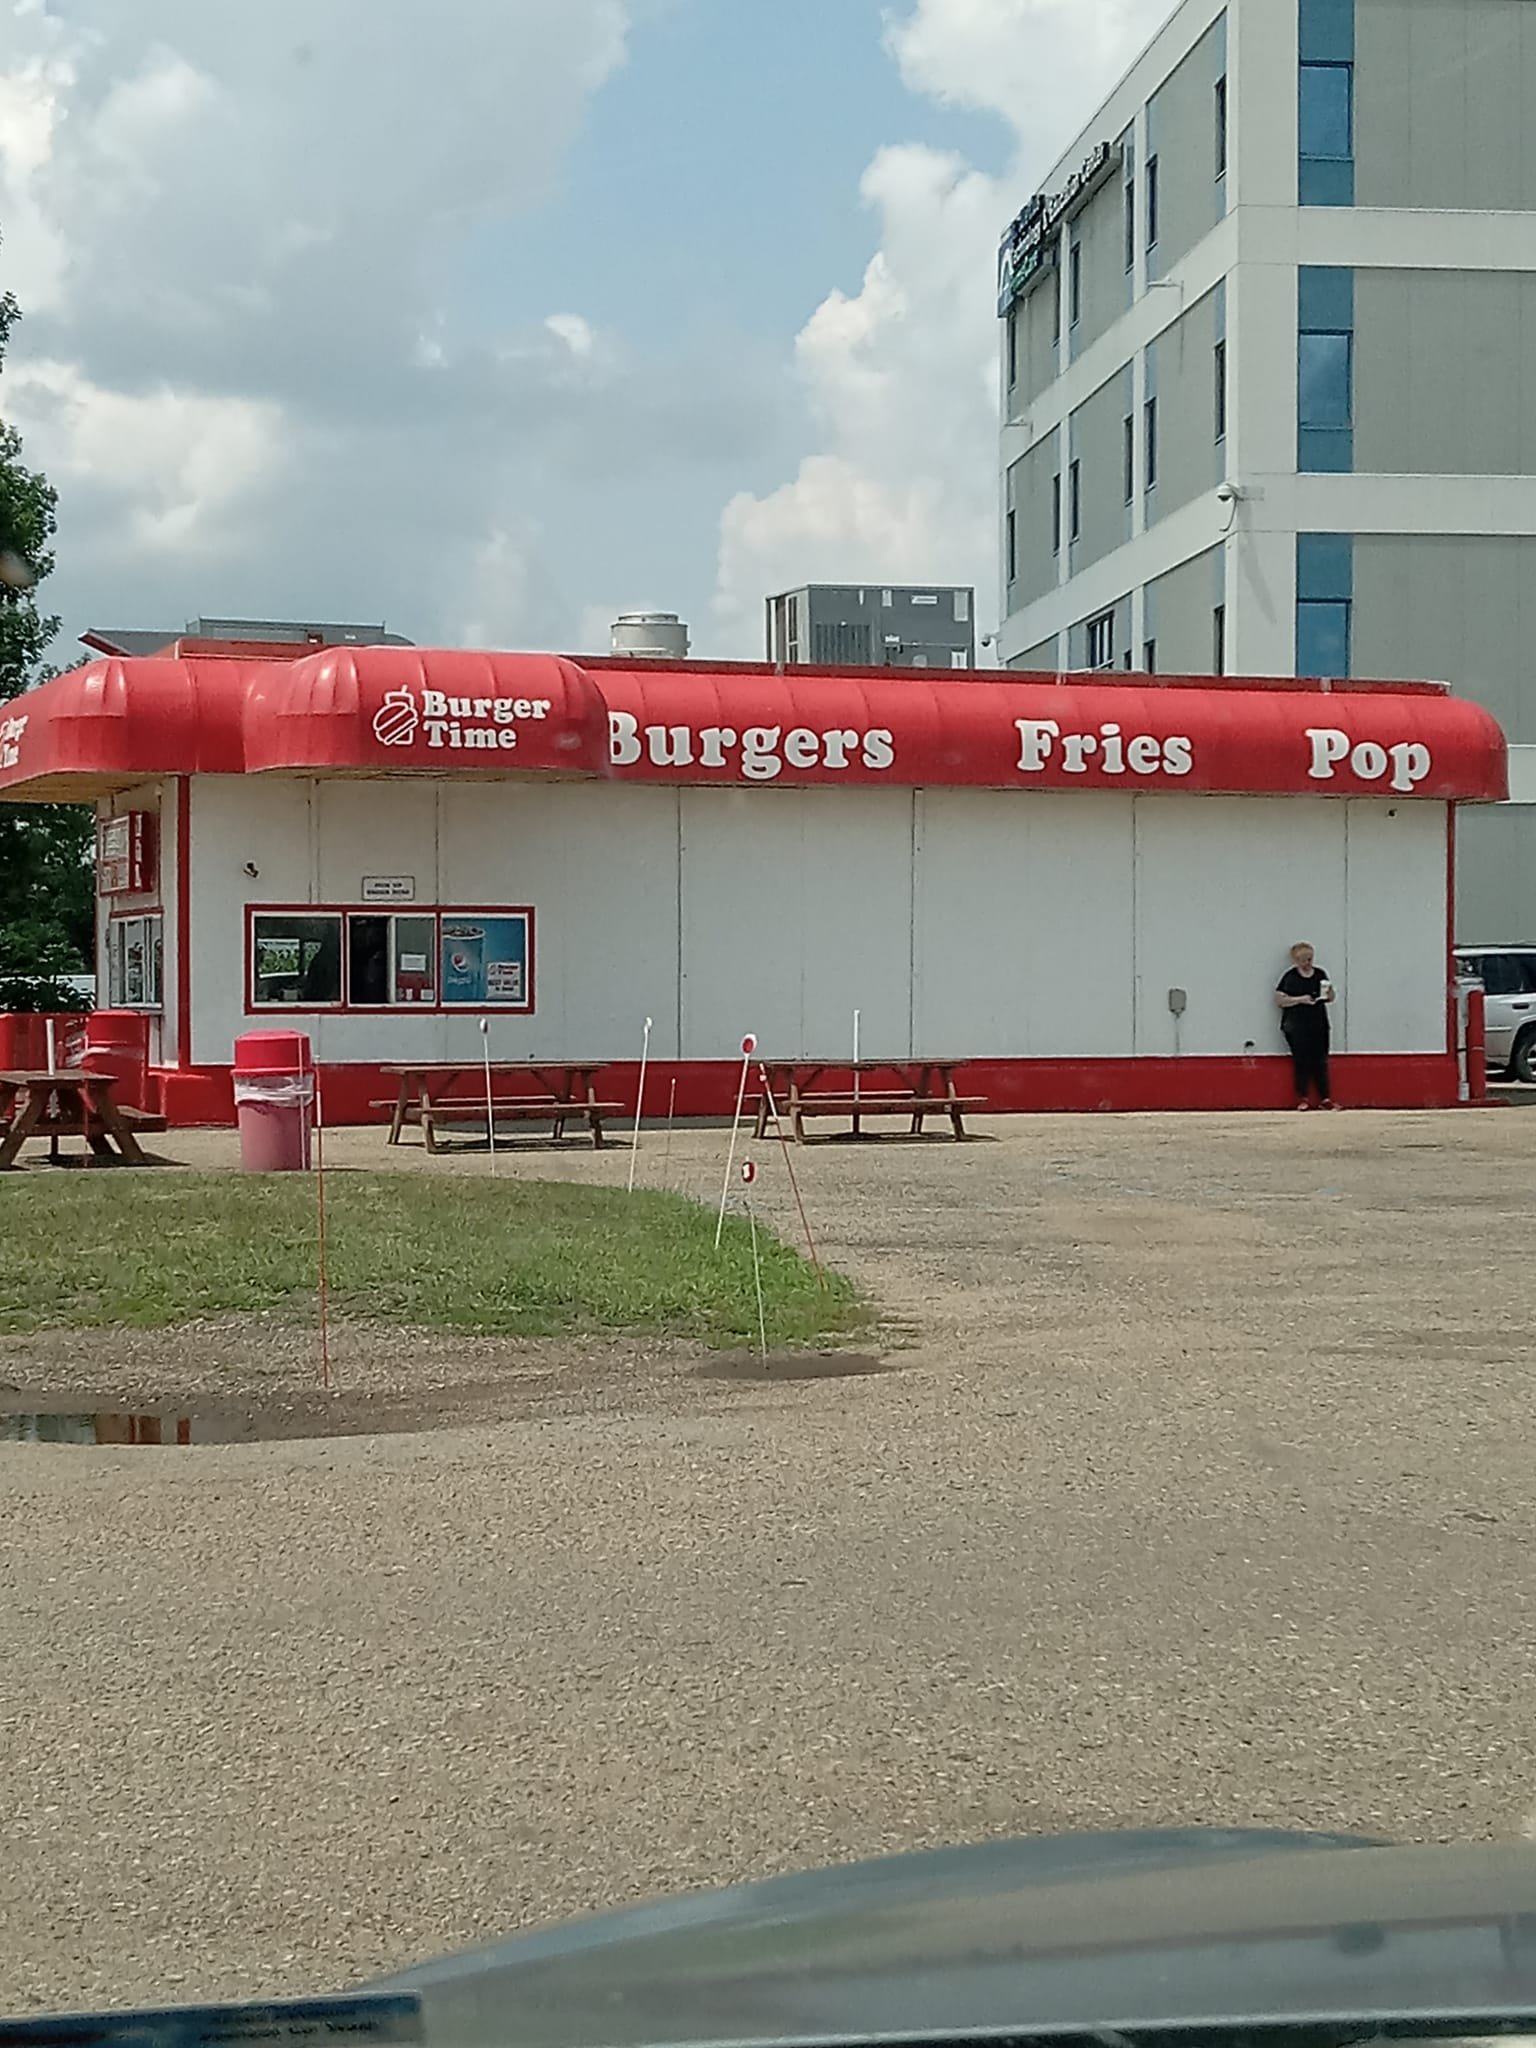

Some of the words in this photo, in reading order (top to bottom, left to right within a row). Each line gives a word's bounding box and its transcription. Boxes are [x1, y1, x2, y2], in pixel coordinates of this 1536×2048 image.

[421, 690, 551, 723] Burger
[423, 720, 517, 748] Time
[608, 711, 894, 779] Burgers
[1015, 719, 1192, 775] Fries
[1305, 728, 1431, 791] Pop
